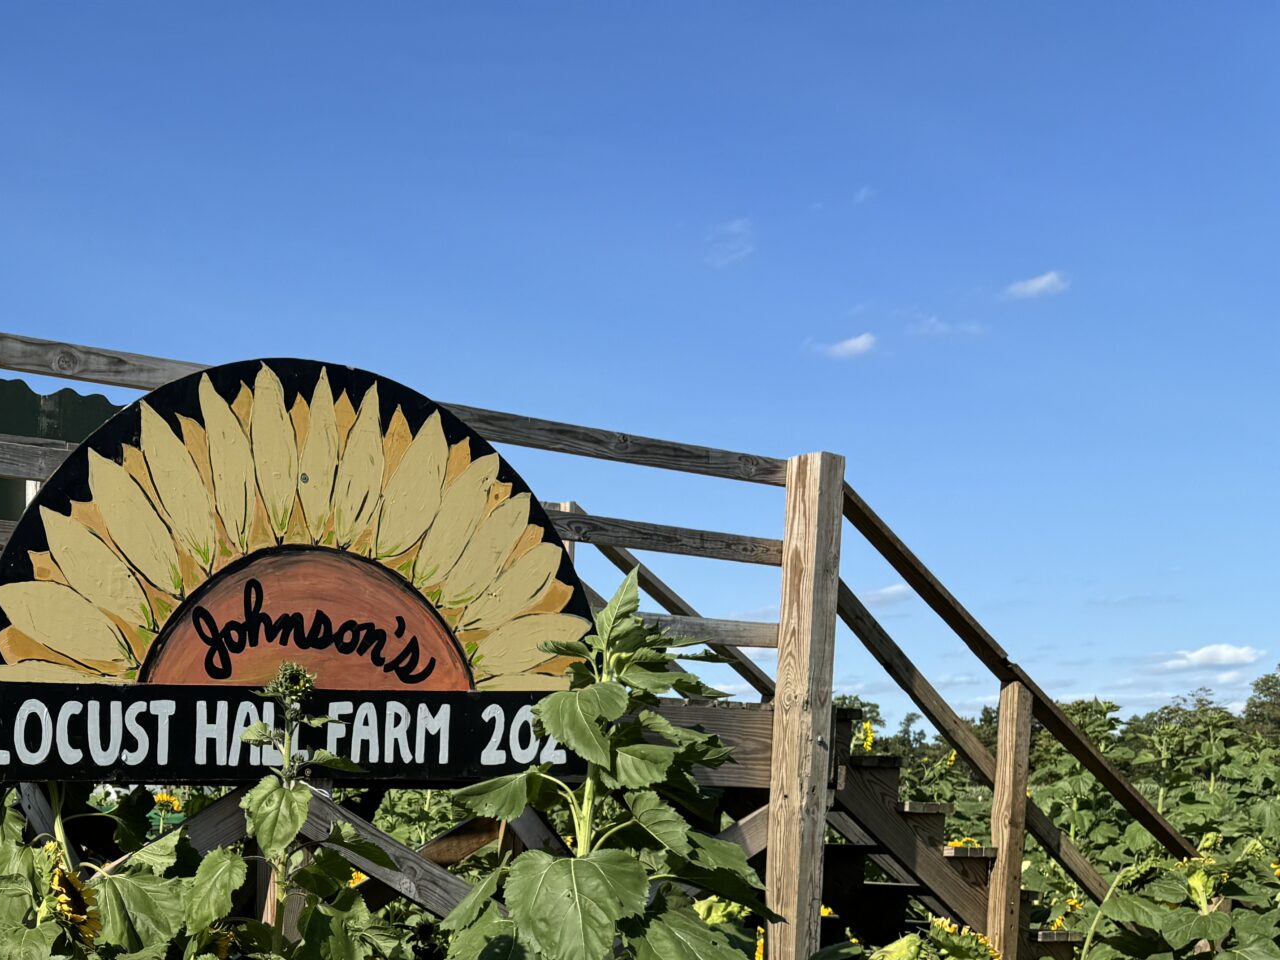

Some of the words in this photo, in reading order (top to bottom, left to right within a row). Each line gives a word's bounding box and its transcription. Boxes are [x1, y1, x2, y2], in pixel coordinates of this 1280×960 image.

[192, 578, 436, 684] Johnson's
[195, 700, 309, 766] HALL
[326, 700, 451, 765] FARM
[480, 703, 569, 766] 202
